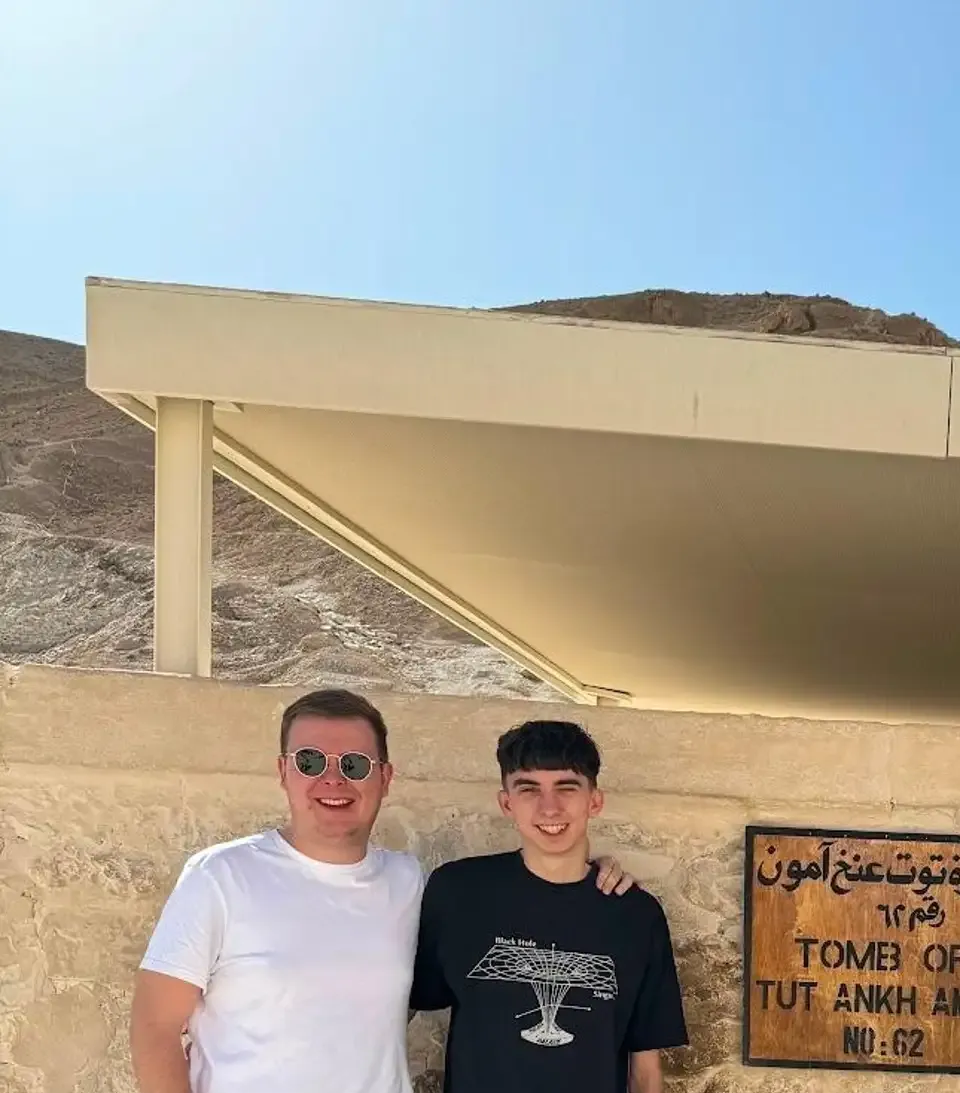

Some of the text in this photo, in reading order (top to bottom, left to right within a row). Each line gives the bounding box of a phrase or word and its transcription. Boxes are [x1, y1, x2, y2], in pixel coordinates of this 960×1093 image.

[757, 841, 839, 892] آمون
[830, 849, 884, 895] عنخ
[889, 853, 947, 895] توت
[877, 896, 946, 932] رقم ٦٢
[794, 938, 902, 971] TOMB
[756, 980, 818, 1011] TUT
[833, 983, 917, 1015] ANKH
